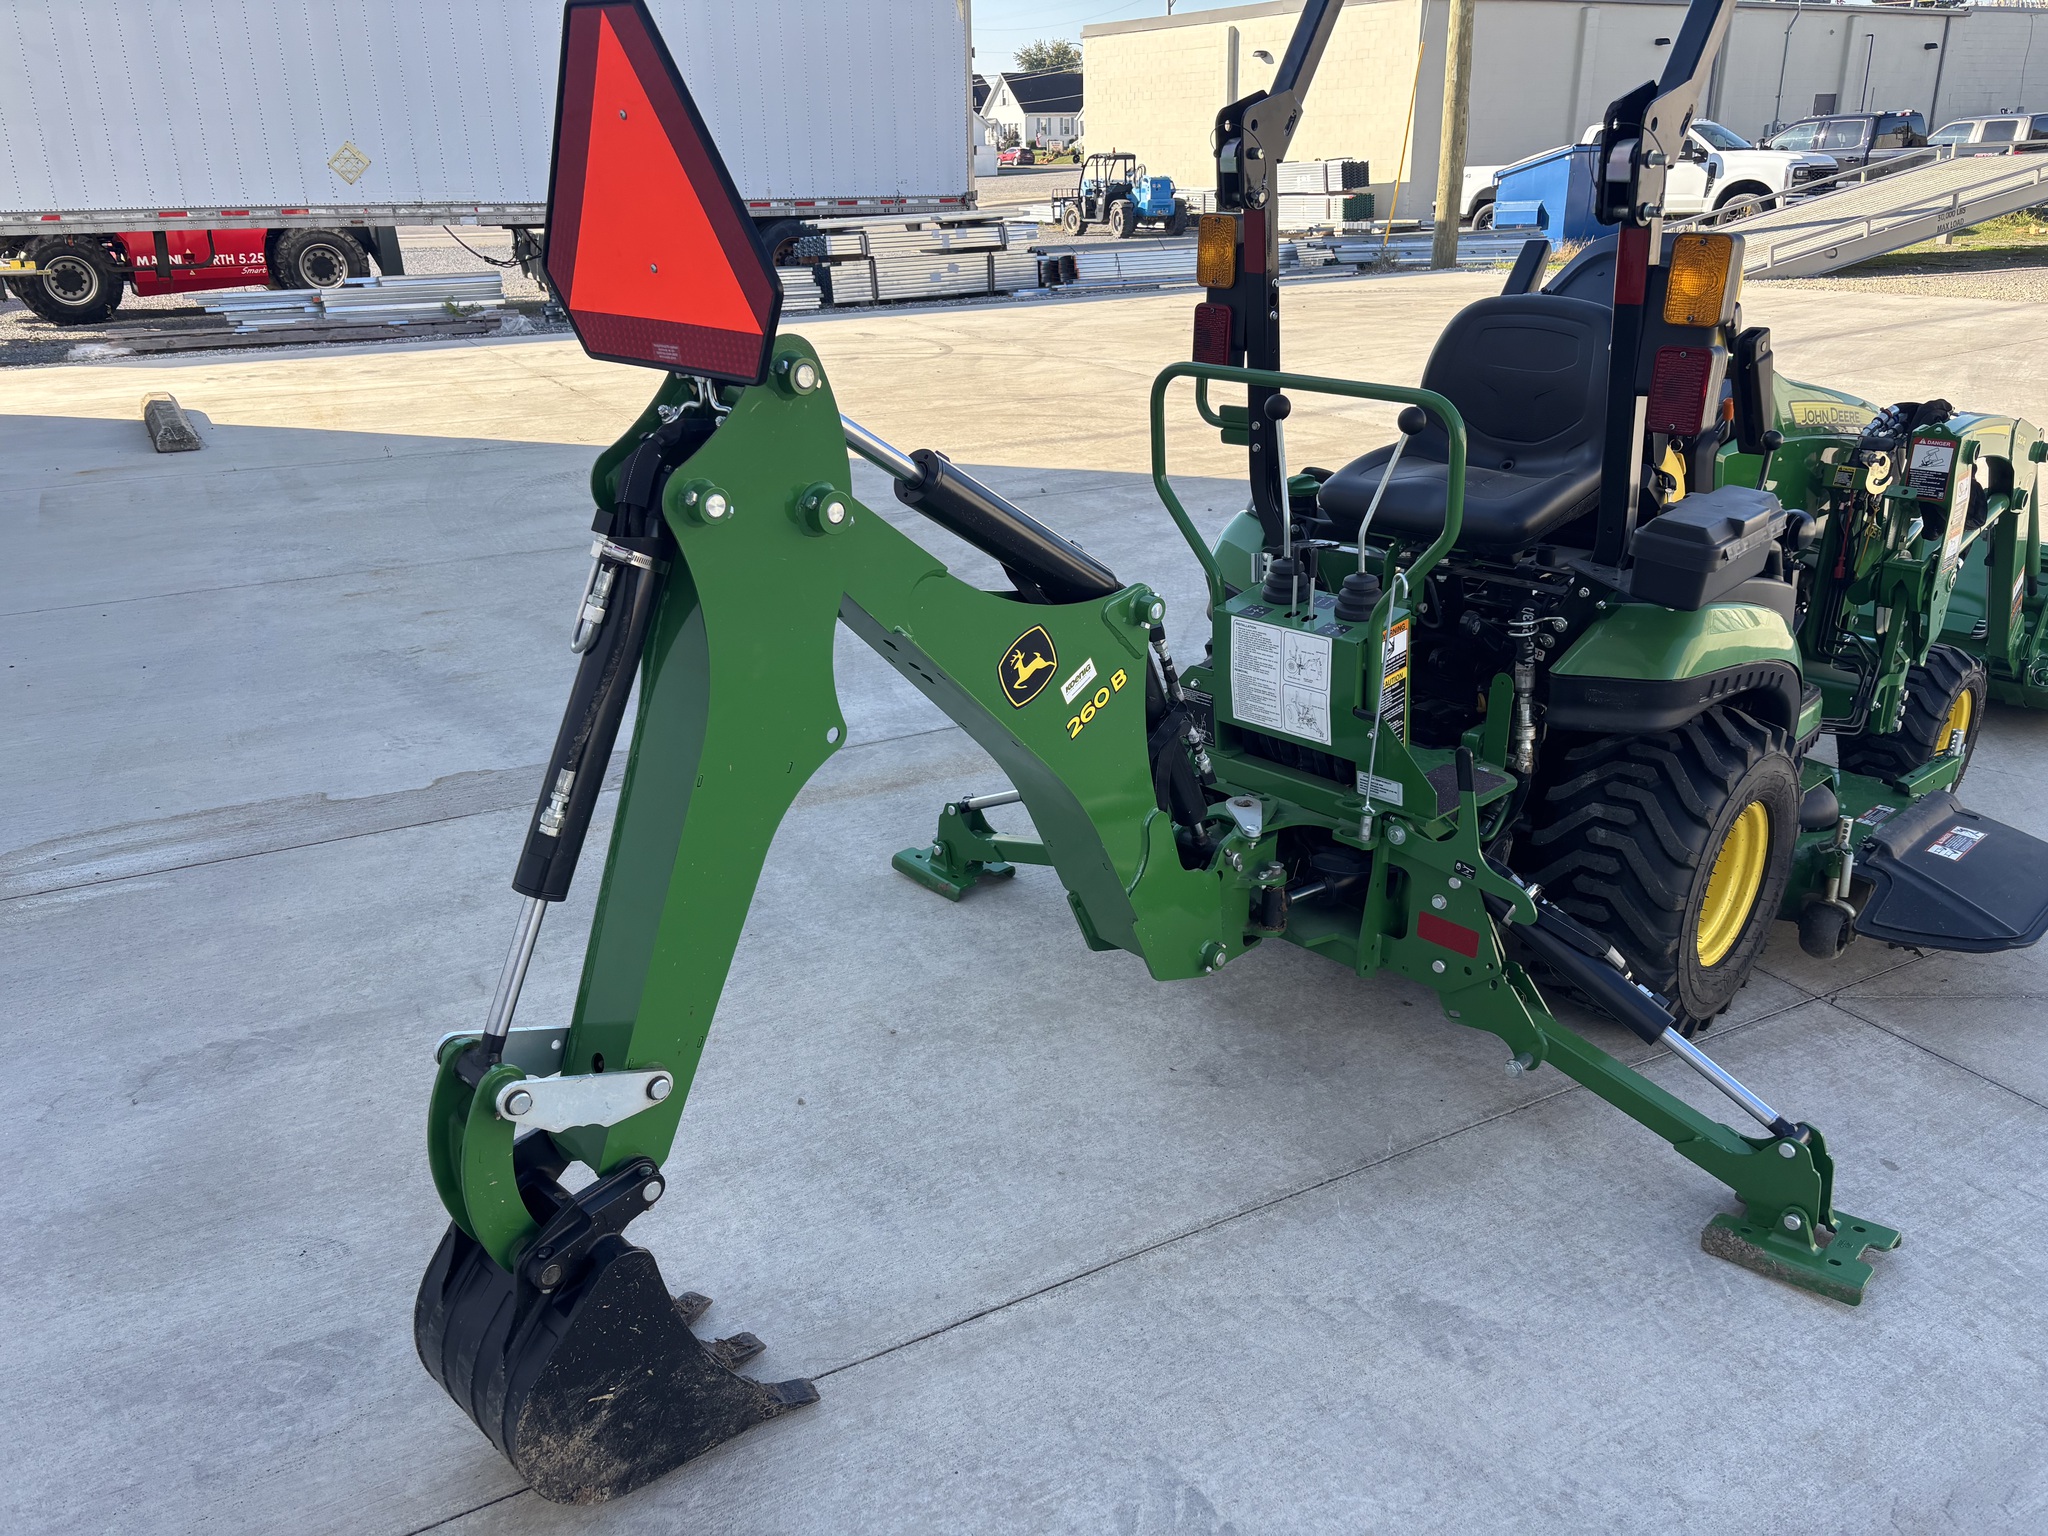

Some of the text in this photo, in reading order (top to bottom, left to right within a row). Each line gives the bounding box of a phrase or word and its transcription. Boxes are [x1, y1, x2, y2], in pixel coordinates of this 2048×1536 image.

[1936, 218, 1964, 232] MAX LOAD
[136, 255, 182, 266] MANI
[238, 252, 265, 264] 5.25
[241, 266, 267, 275] Smart
[1801, 407, 1861, 424] JOHN DEERE
[1235, 621, 1257, 630] INSTALLATION
[1384, 671, 1404, 688] AUTION
[1066, 685, 1110, 740] 260
[1110, 667, 1128, 694] B
